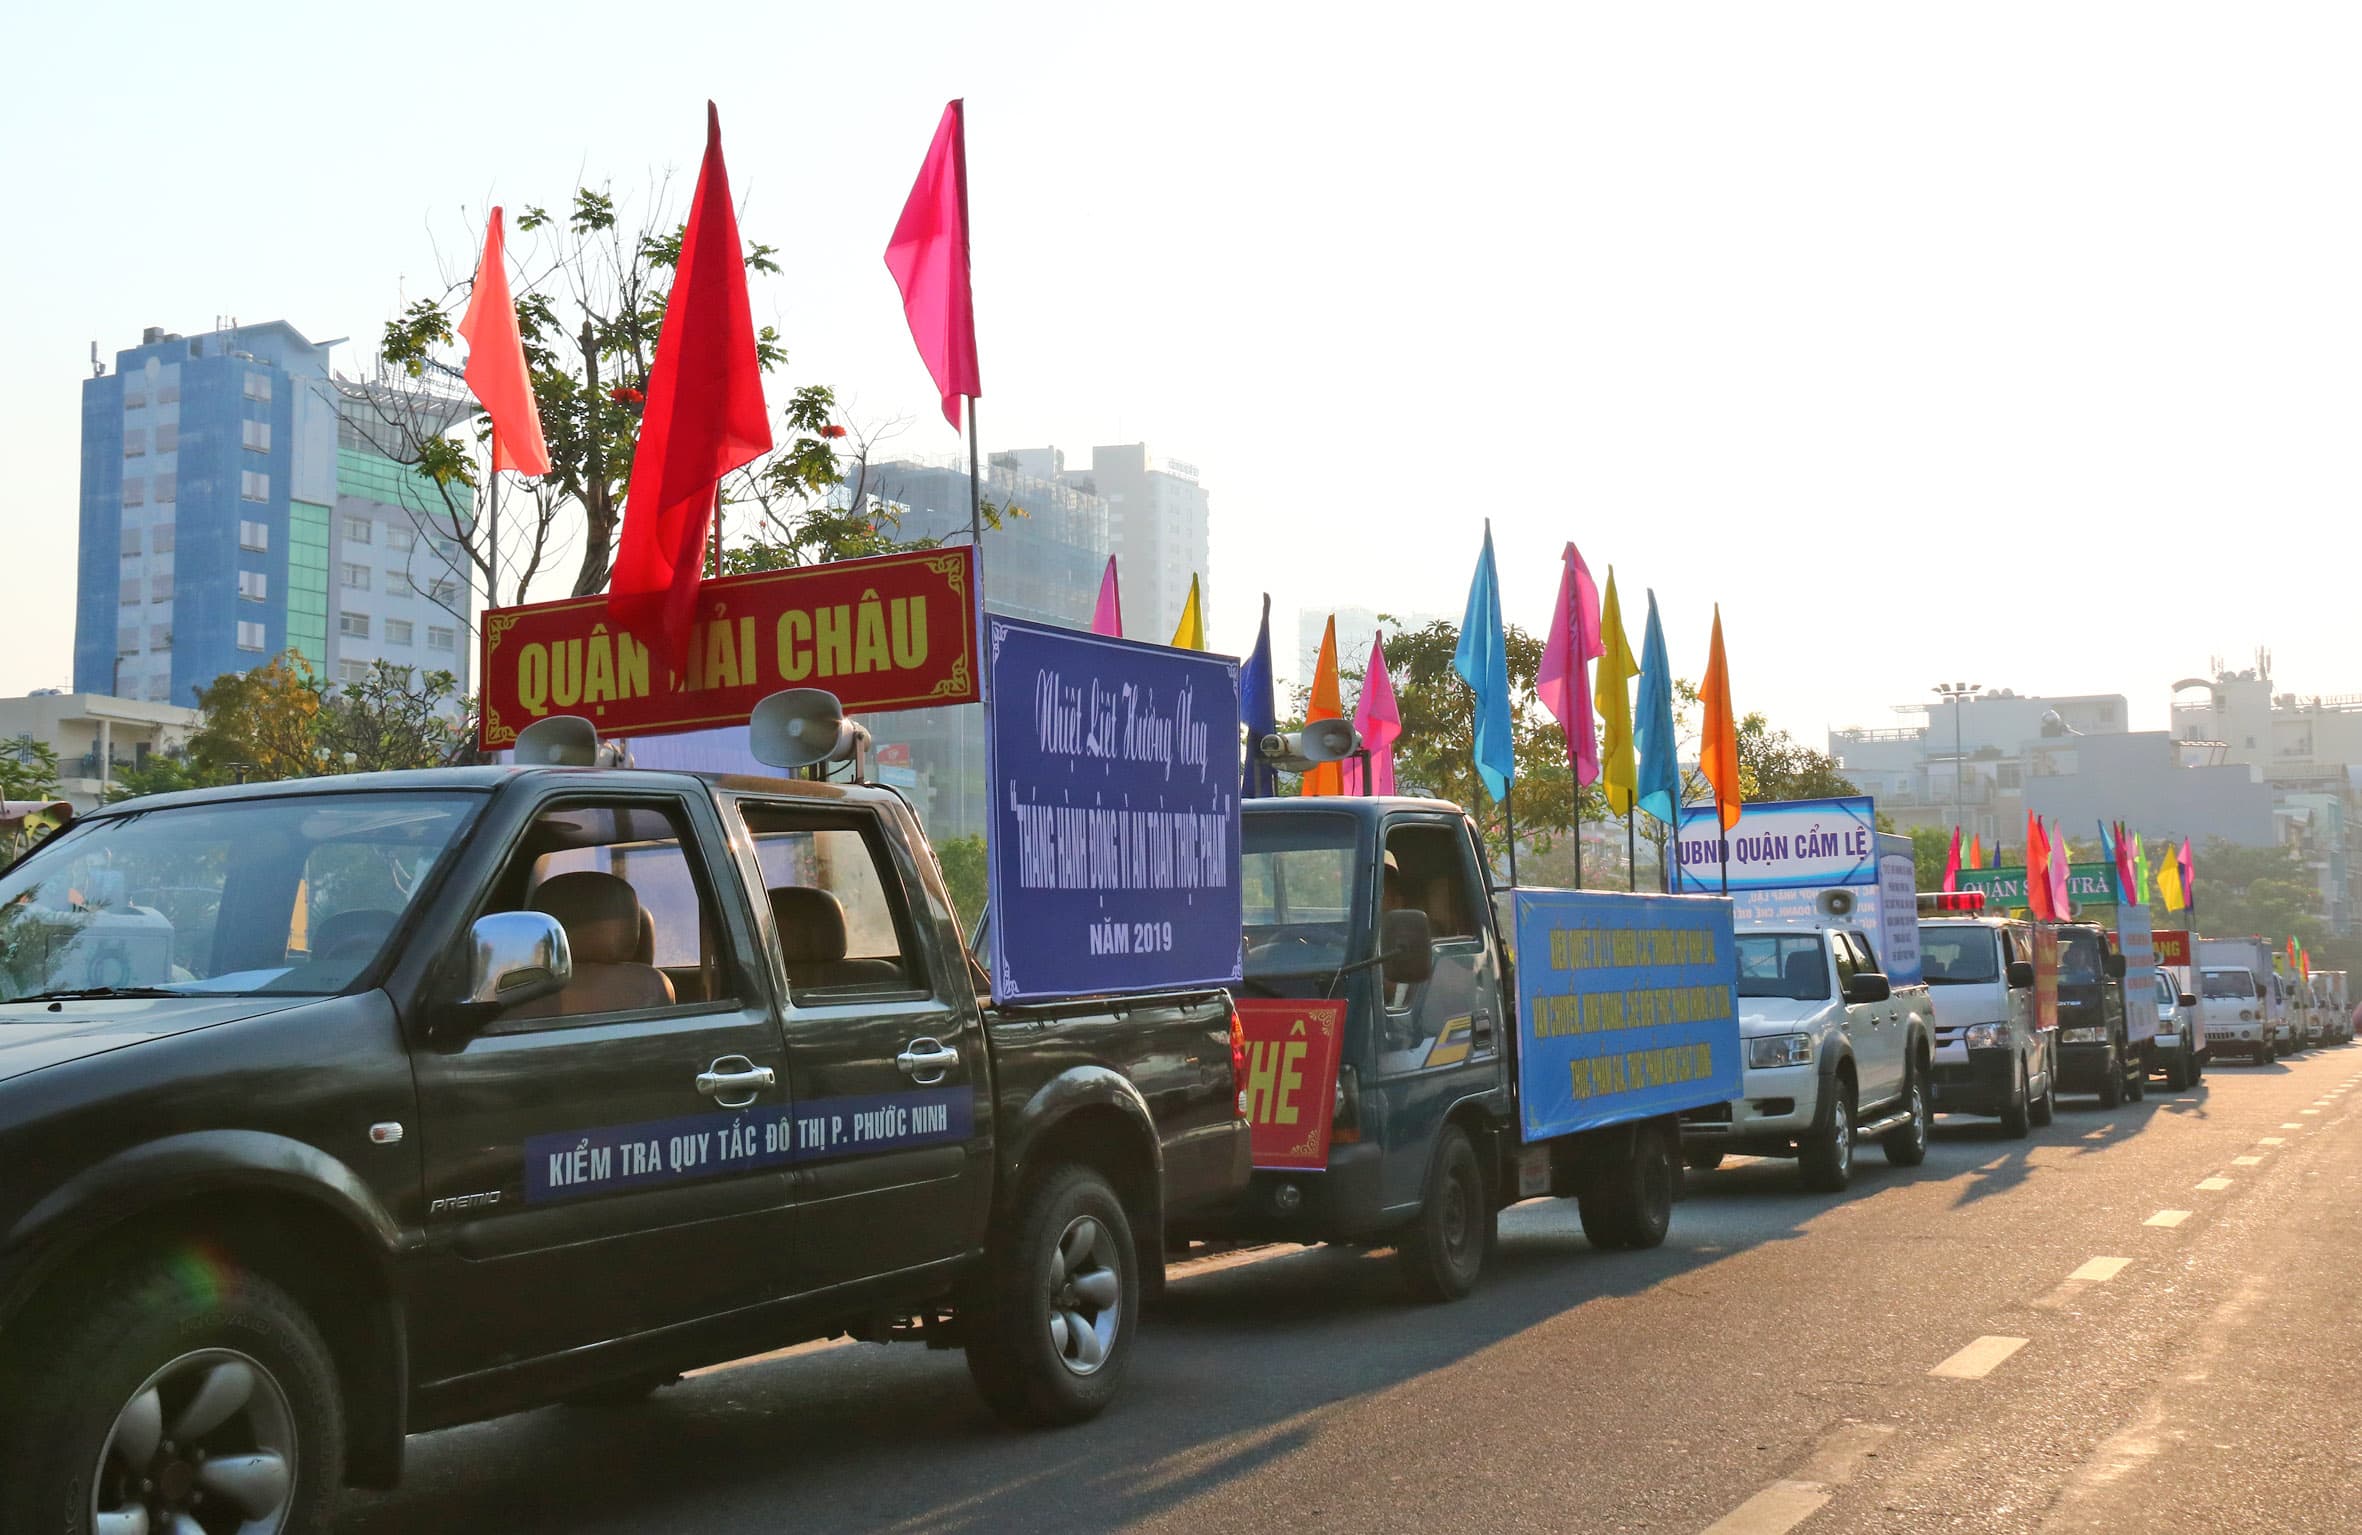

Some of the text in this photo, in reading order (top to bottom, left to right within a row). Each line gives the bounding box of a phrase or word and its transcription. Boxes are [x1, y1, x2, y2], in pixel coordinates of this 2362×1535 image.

[517, 588, 929, 716] QUẬN ẢI CHÂU
[1035, 668, 1209, 784] Nhiệt Liệt Hưởng Ứng
[1056, 788, 1088, 889] HÀNH
[1088, 791, 1119, 908] ĐỘNG
[1119, 792, 1131, 889] VÌ
[1132, 811, 1147, 889] AN
[1147, 794, 1174, 889] TOÀN
[1174, 805, 1199, 906] THỰC
[1679, 823, 1867, 866] UBND QUẬN CẨM LỆ
[2067, 872, 2110, 894] TRÀ
[1089, 917, 1172, 956] NĂM 2019
[1244, 1019, 1307, 1124] HÊ
[549, 1103, 948, 1188] KIỂM TRA QUY TẮC ĐÔ THỊ P. PHƯỚC NINH
